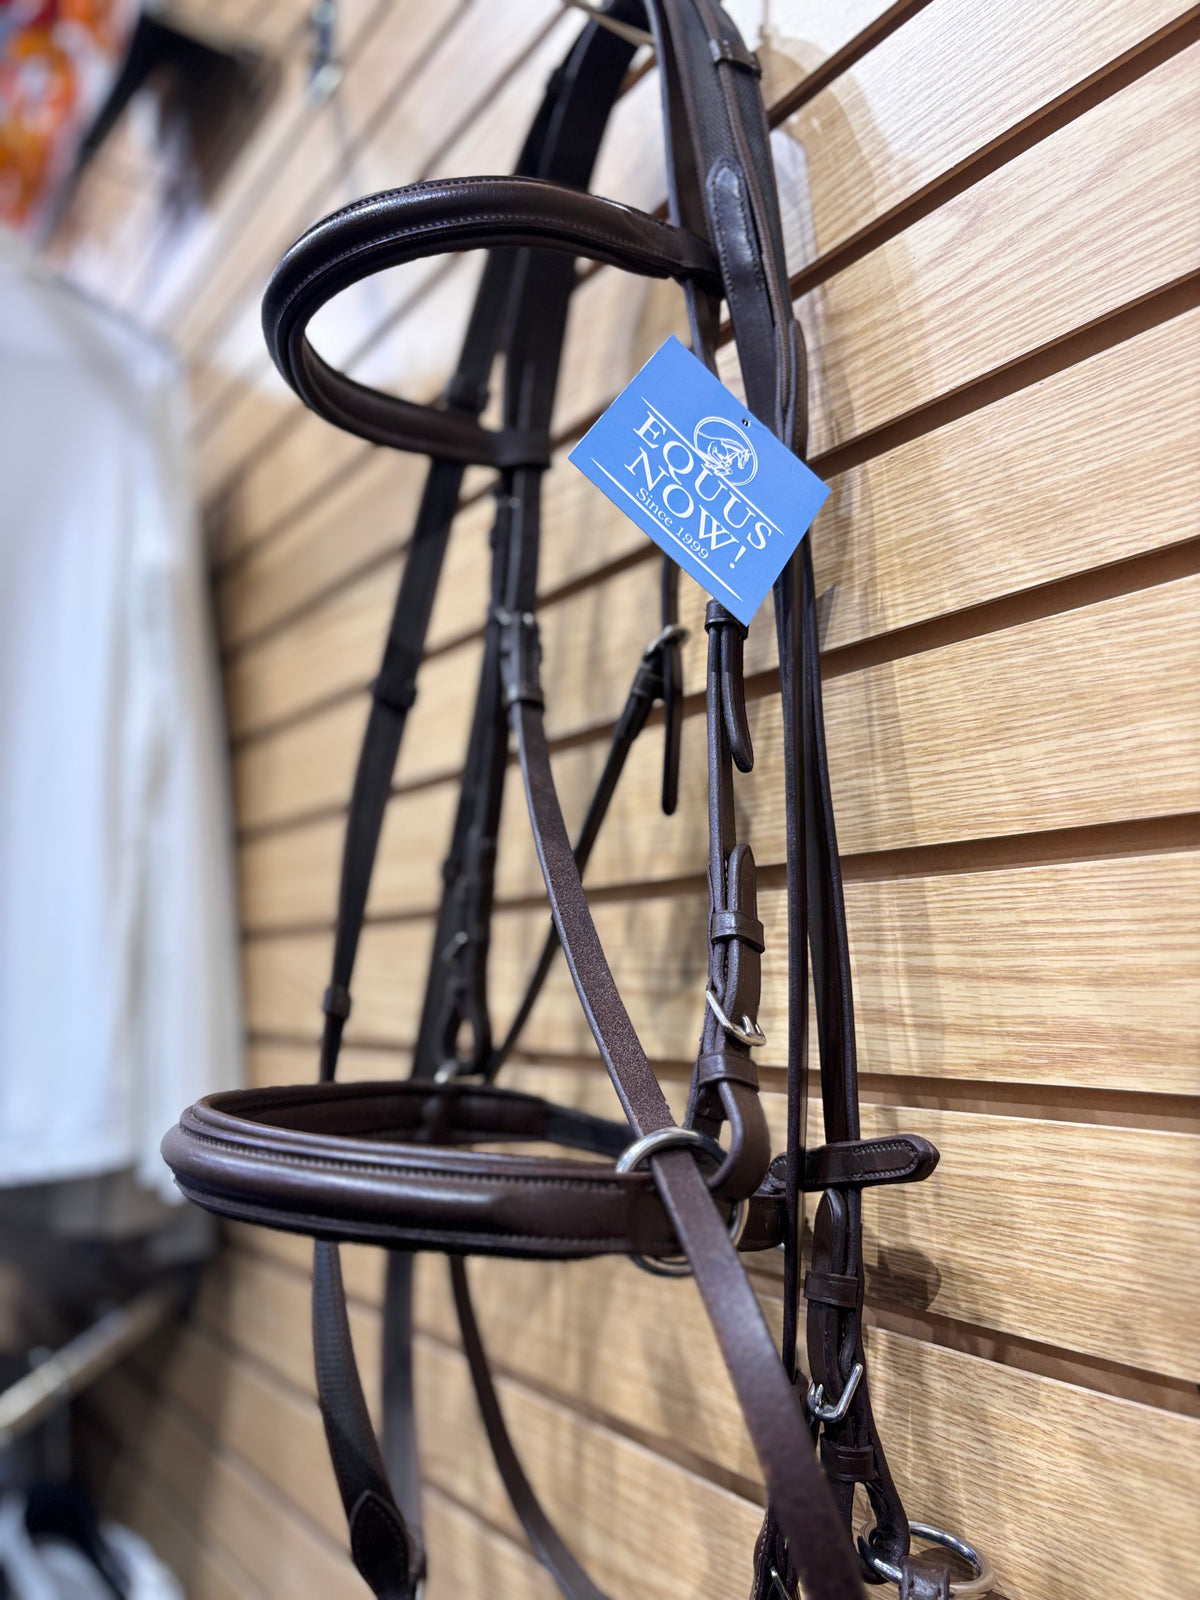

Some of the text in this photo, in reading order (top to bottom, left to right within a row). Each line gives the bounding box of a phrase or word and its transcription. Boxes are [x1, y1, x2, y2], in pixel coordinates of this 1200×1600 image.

[624, 446, 747, 569] NOW!
[633, 411, 772, 550] EQUUS
[635, 487, 709, 559] Since 1999
